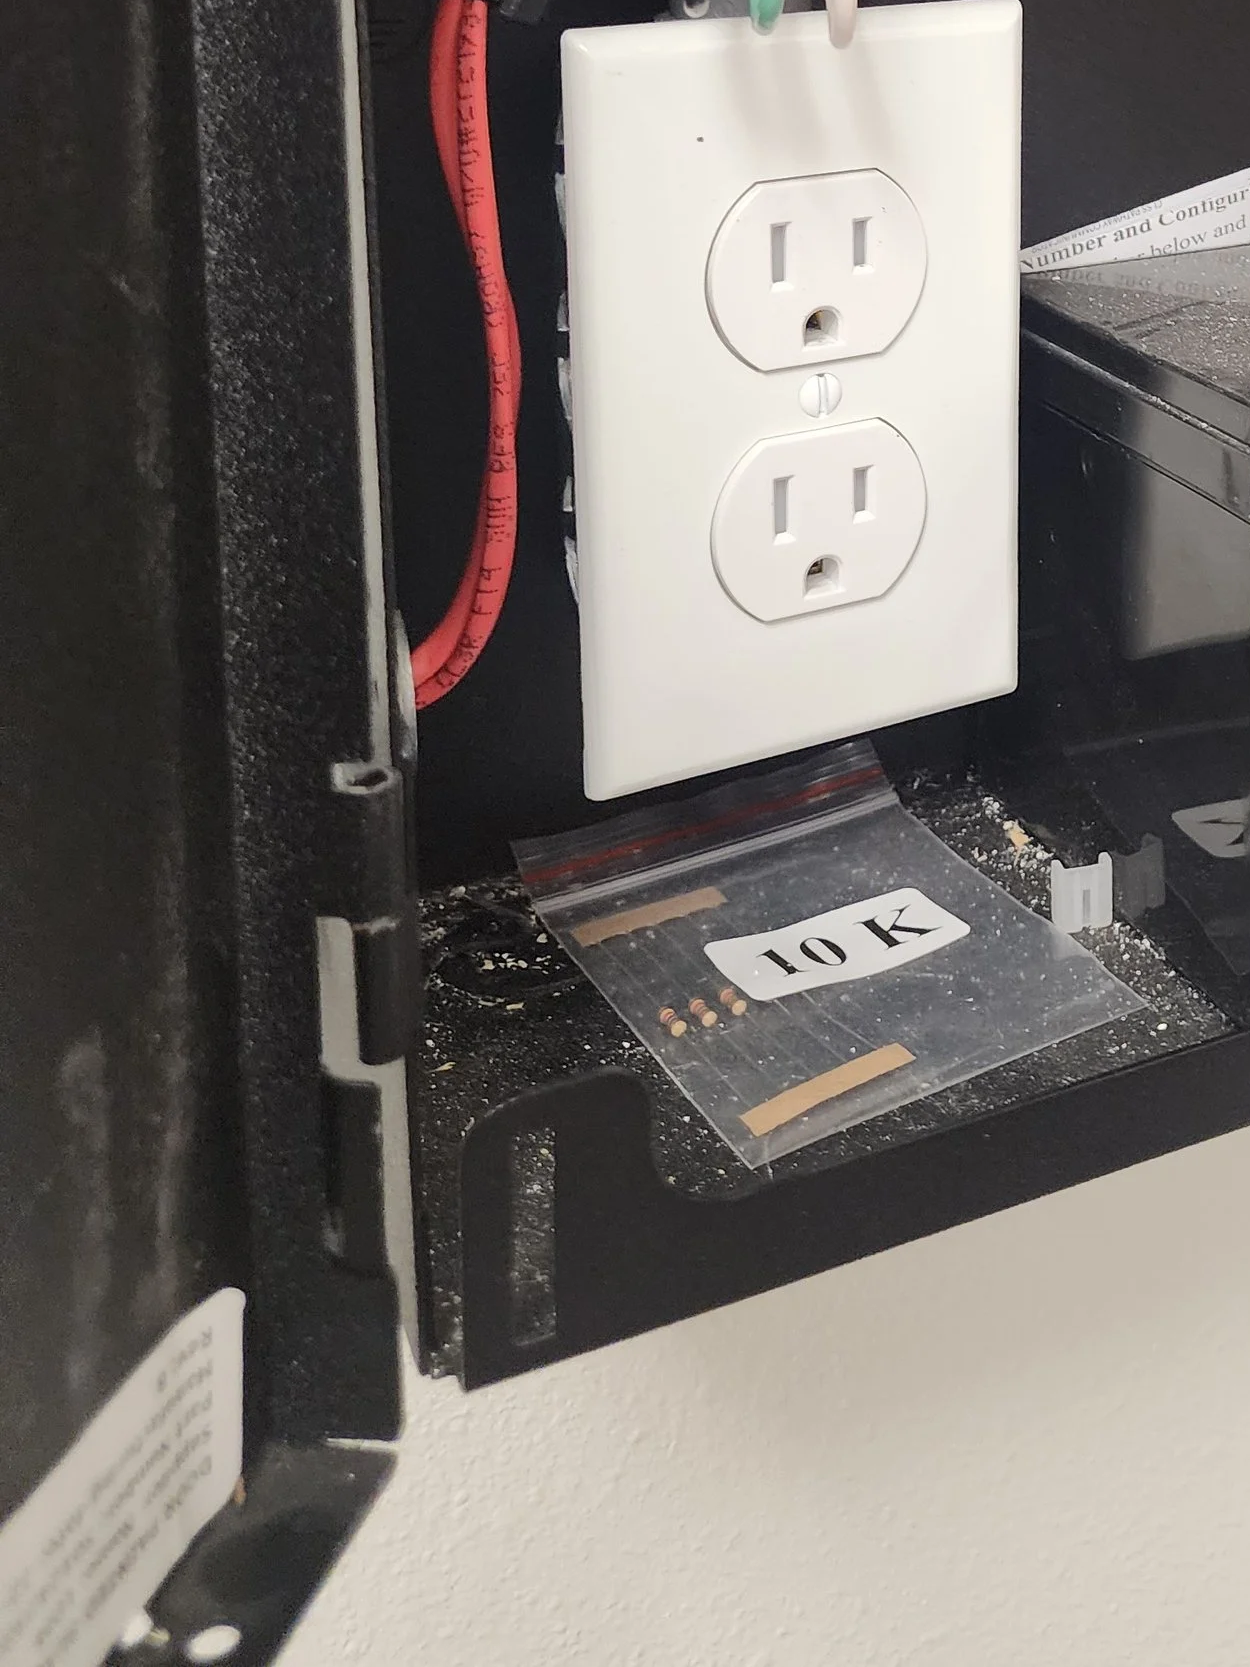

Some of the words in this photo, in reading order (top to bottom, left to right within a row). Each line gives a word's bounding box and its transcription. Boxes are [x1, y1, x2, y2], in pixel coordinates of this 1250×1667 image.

[1114, 219, 1151, 242] and
[756, 937, 846, 978] 10
[856, 904, 941, 949] K
